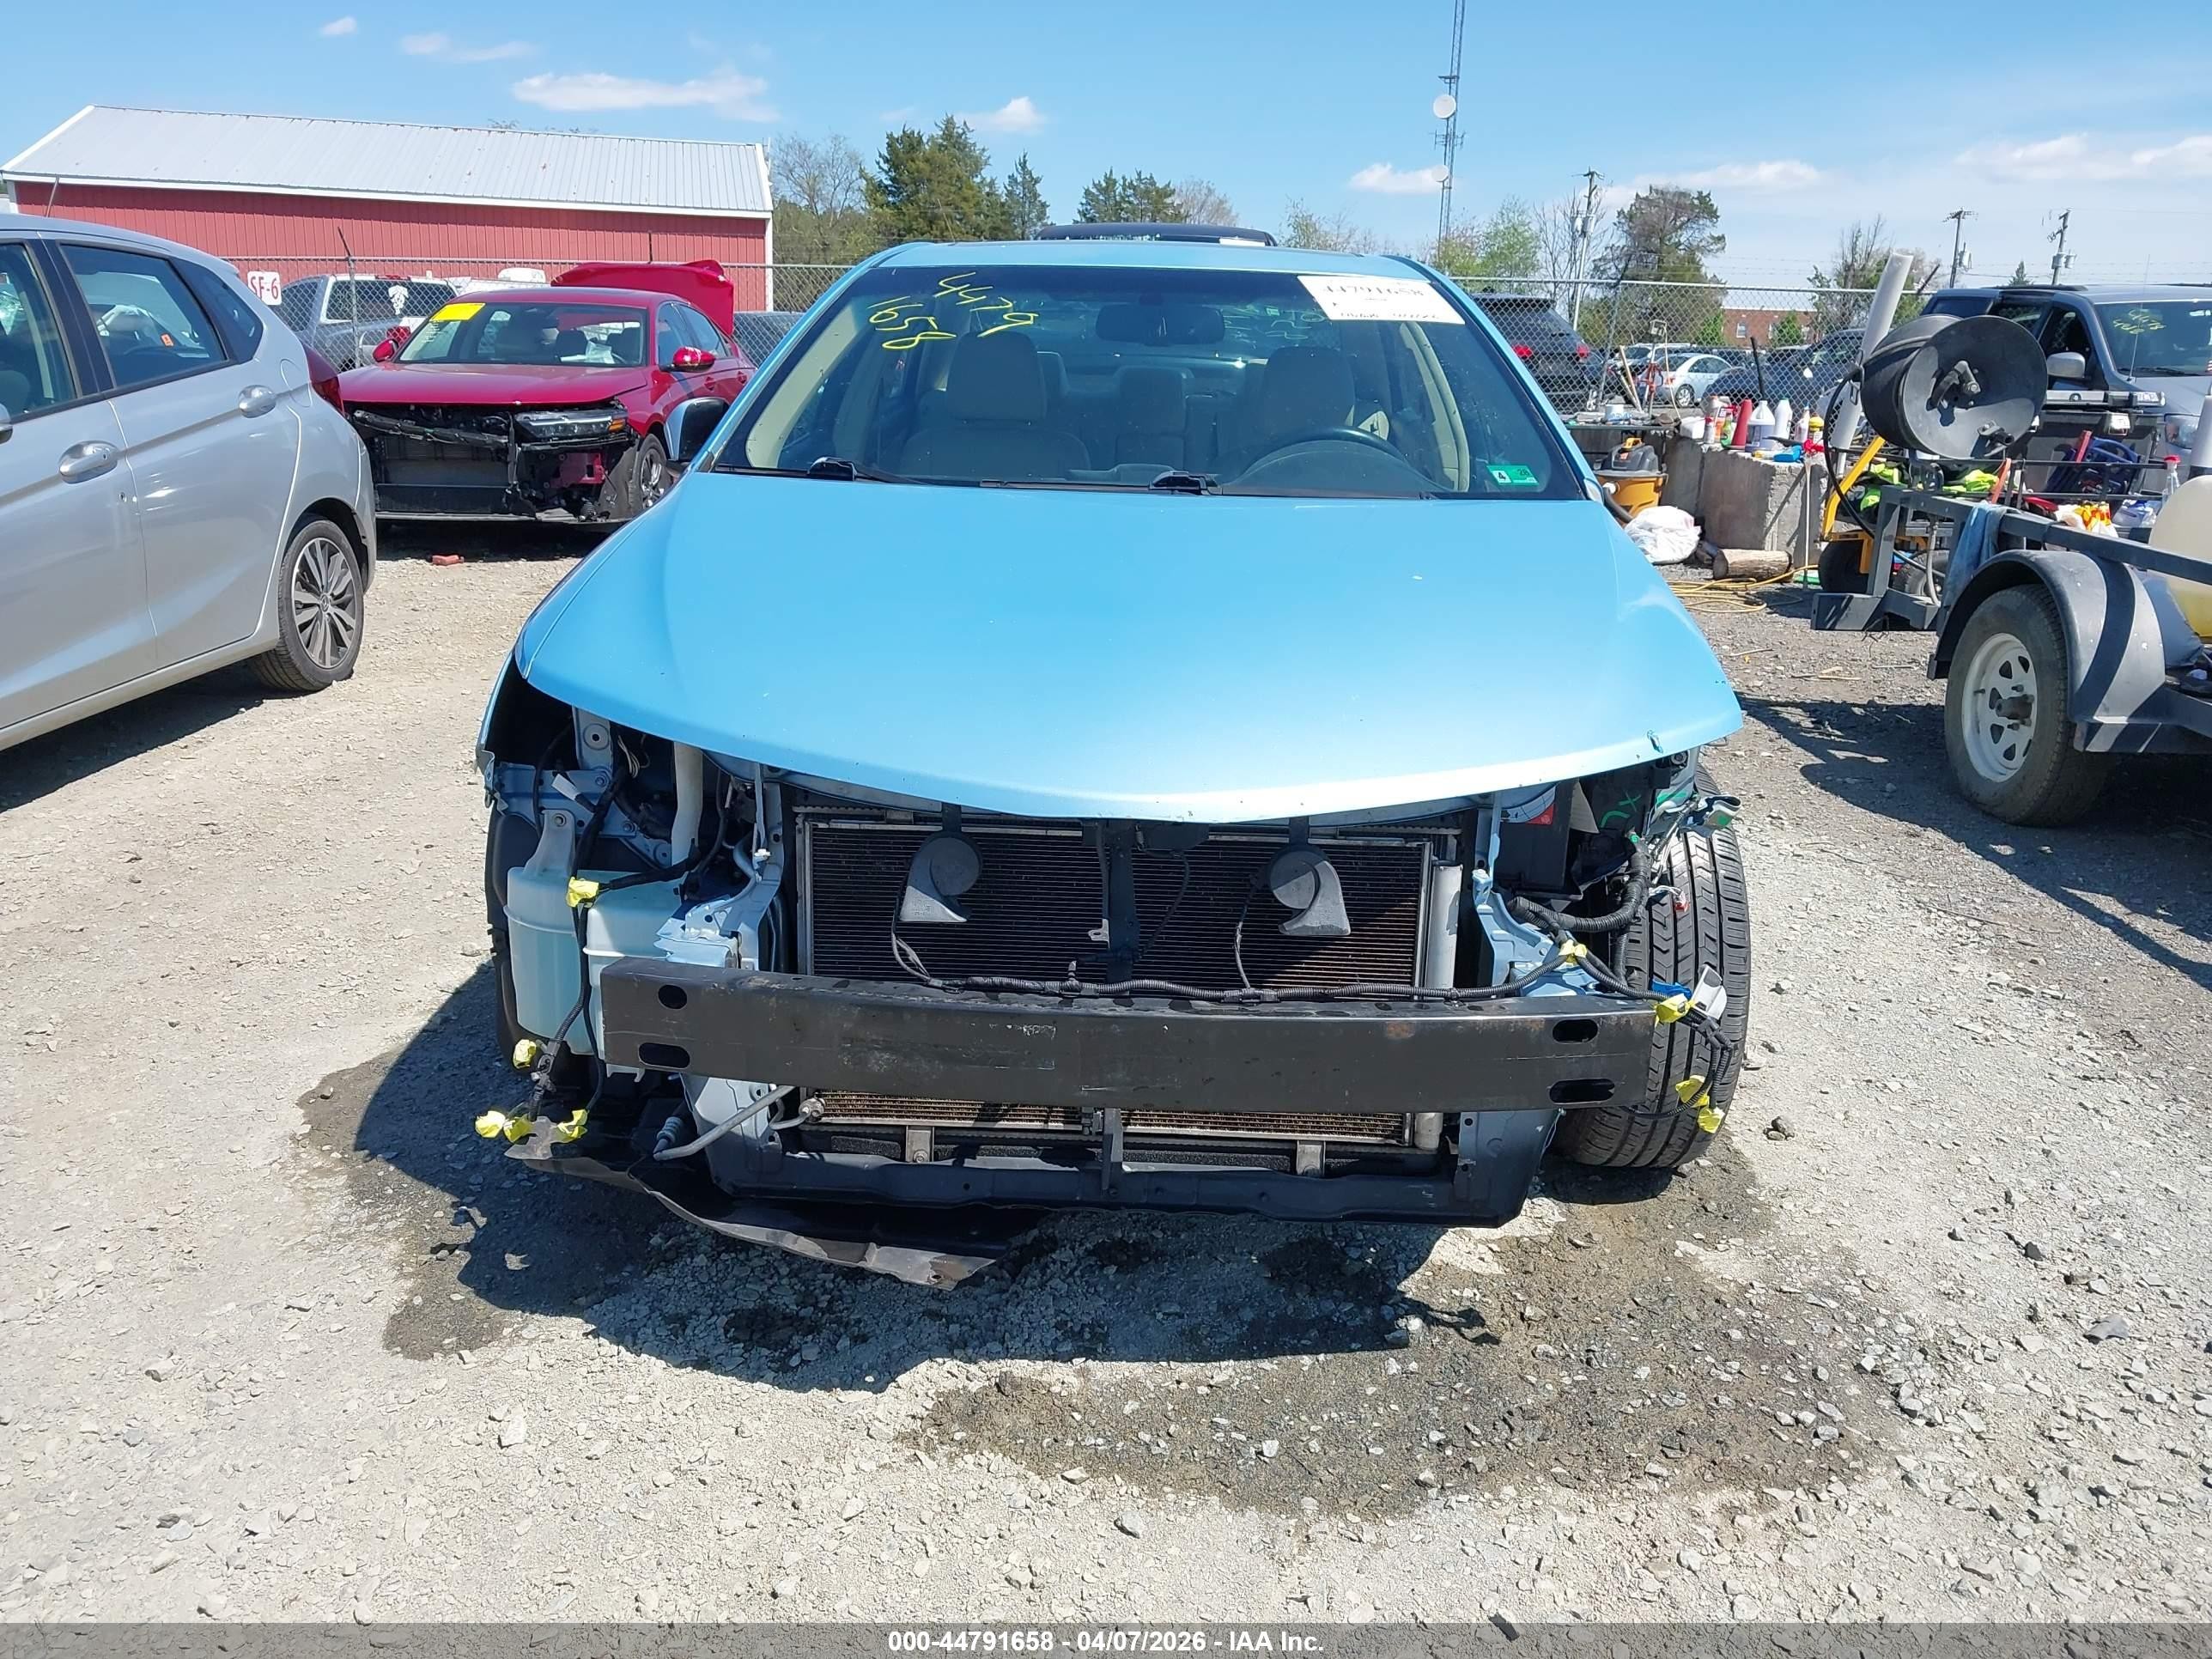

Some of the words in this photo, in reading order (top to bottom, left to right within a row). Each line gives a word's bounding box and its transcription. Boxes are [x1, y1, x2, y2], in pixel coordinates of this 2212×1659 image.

[251, 276, 279, 300] SF-6
[933, 271, 1040, 337] 4479
[867, 295, 957, 349] 1658
[1497, 471, 1506, 480] 4
